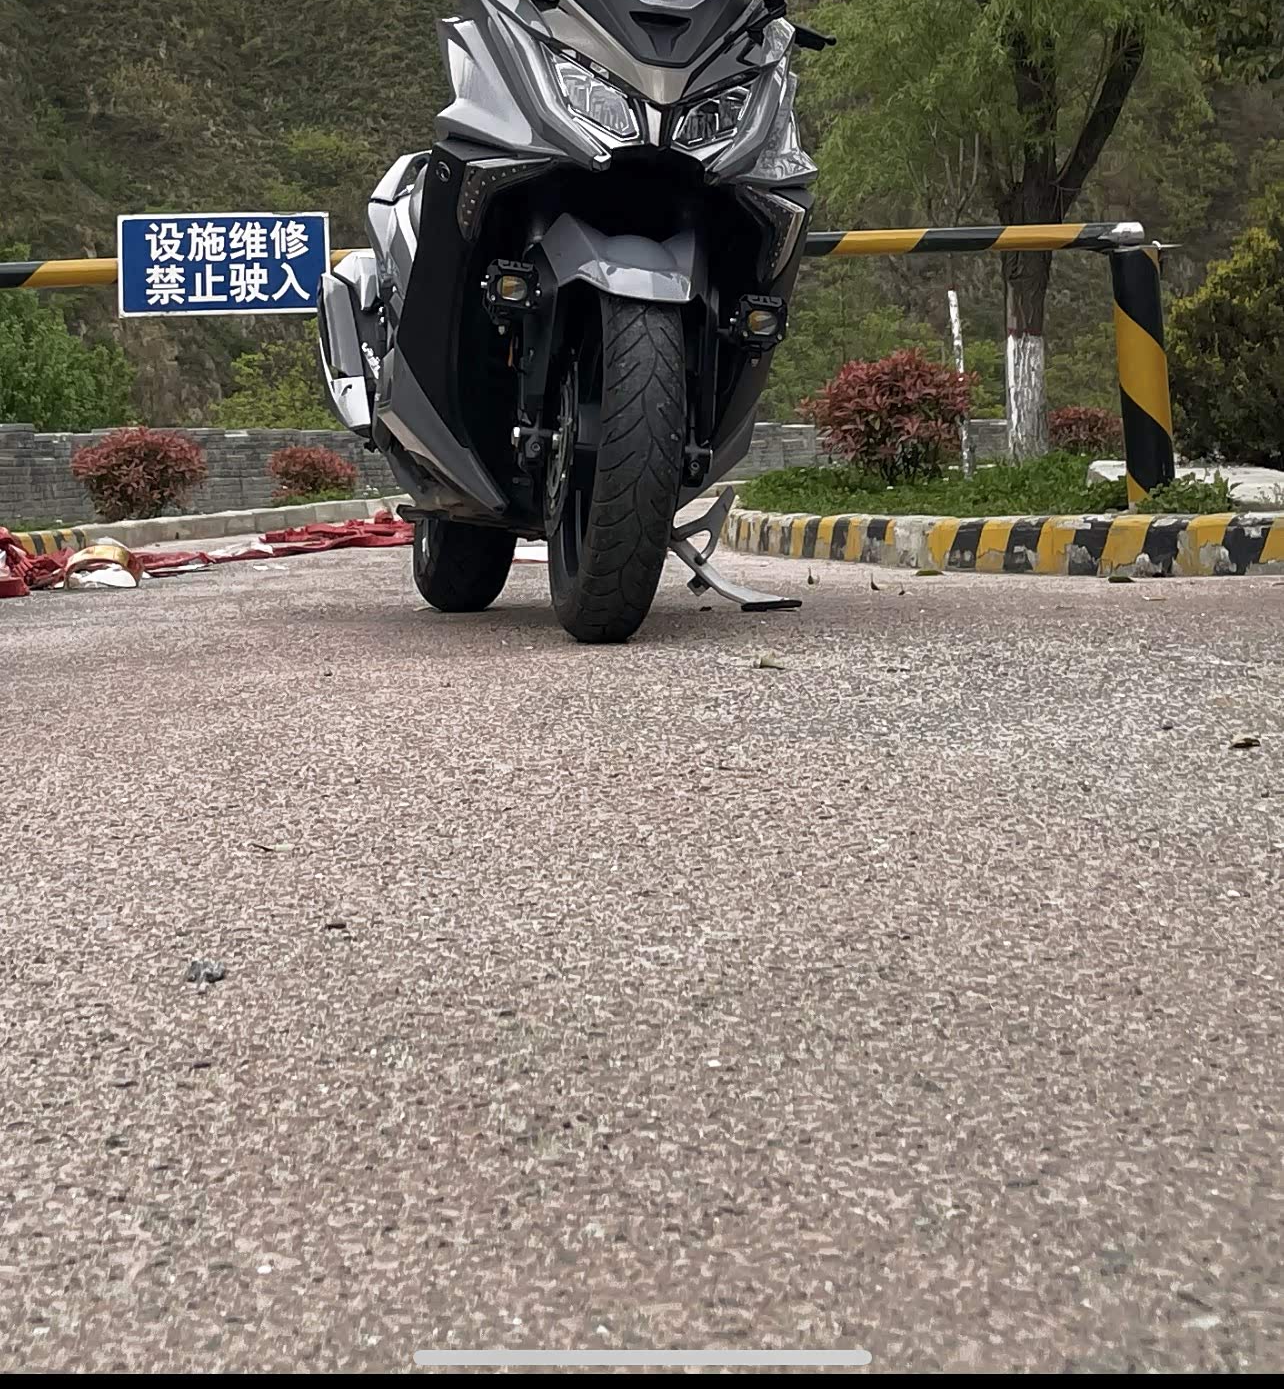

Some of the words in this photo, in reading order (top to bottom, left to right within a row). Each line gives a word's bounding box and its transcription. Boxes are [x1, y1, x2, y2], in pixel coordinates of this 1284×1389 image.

[145, 220, 309, 262] 设施维修
[145, 262, 311, 305] 禁止驶入
